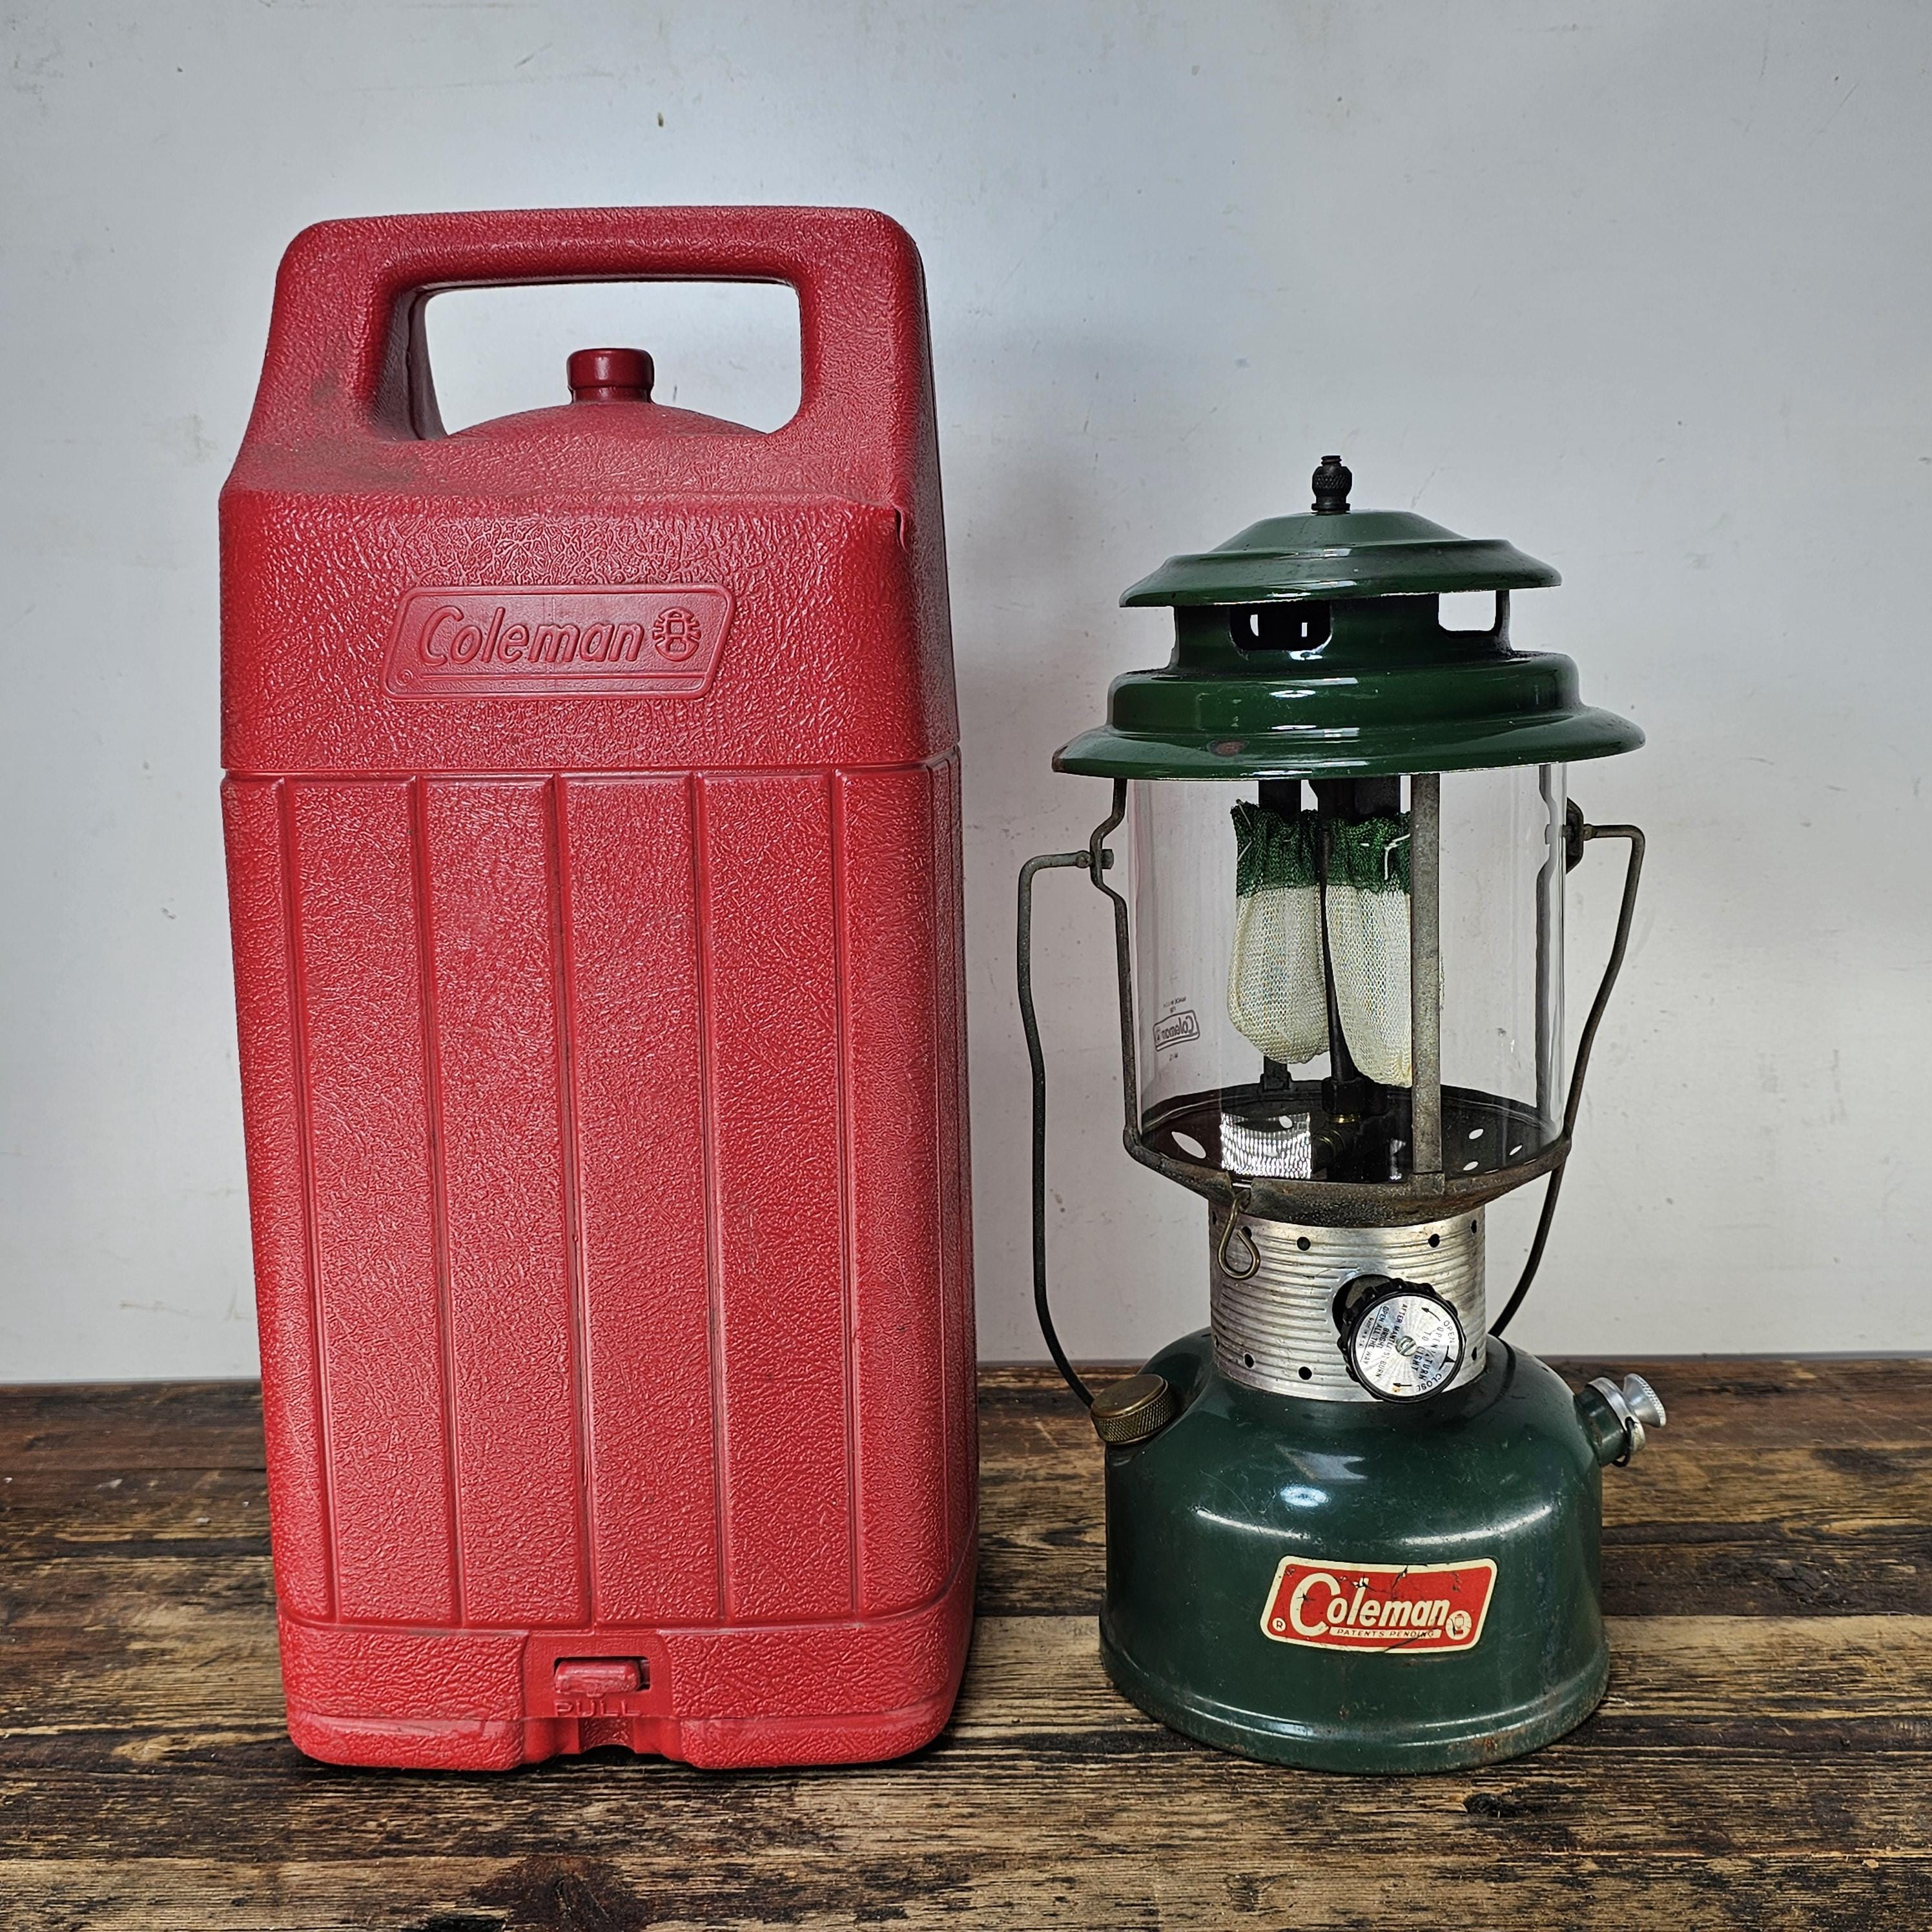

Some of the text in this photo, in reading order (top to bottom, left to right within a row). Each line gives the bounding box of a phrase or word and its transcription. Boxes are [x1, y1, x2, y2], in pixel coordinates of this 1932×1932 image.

[419, 604, 645, 666] Coleman
[1377, 1305, 1390, 1322] OPEN
[1396, 1303, 1408, 1323] AFTER
[1373, 1322, 1382, 1335] ALL
[1443, 1321, 1455, 1342] OPEN
[1368, 1336, 1377, 1348] THE
[1410, 1345, 1424, 1371] LIGHT
[1375, 1360, 1386, 1377] BURN
[1417, 1357, 1432, 1381] TURN
[1416, 1373, 1442, 1392] CLOSE
[1290, 1572, 1450, 1637] Coleman
[553, 1699, 641, 1718] PULL
